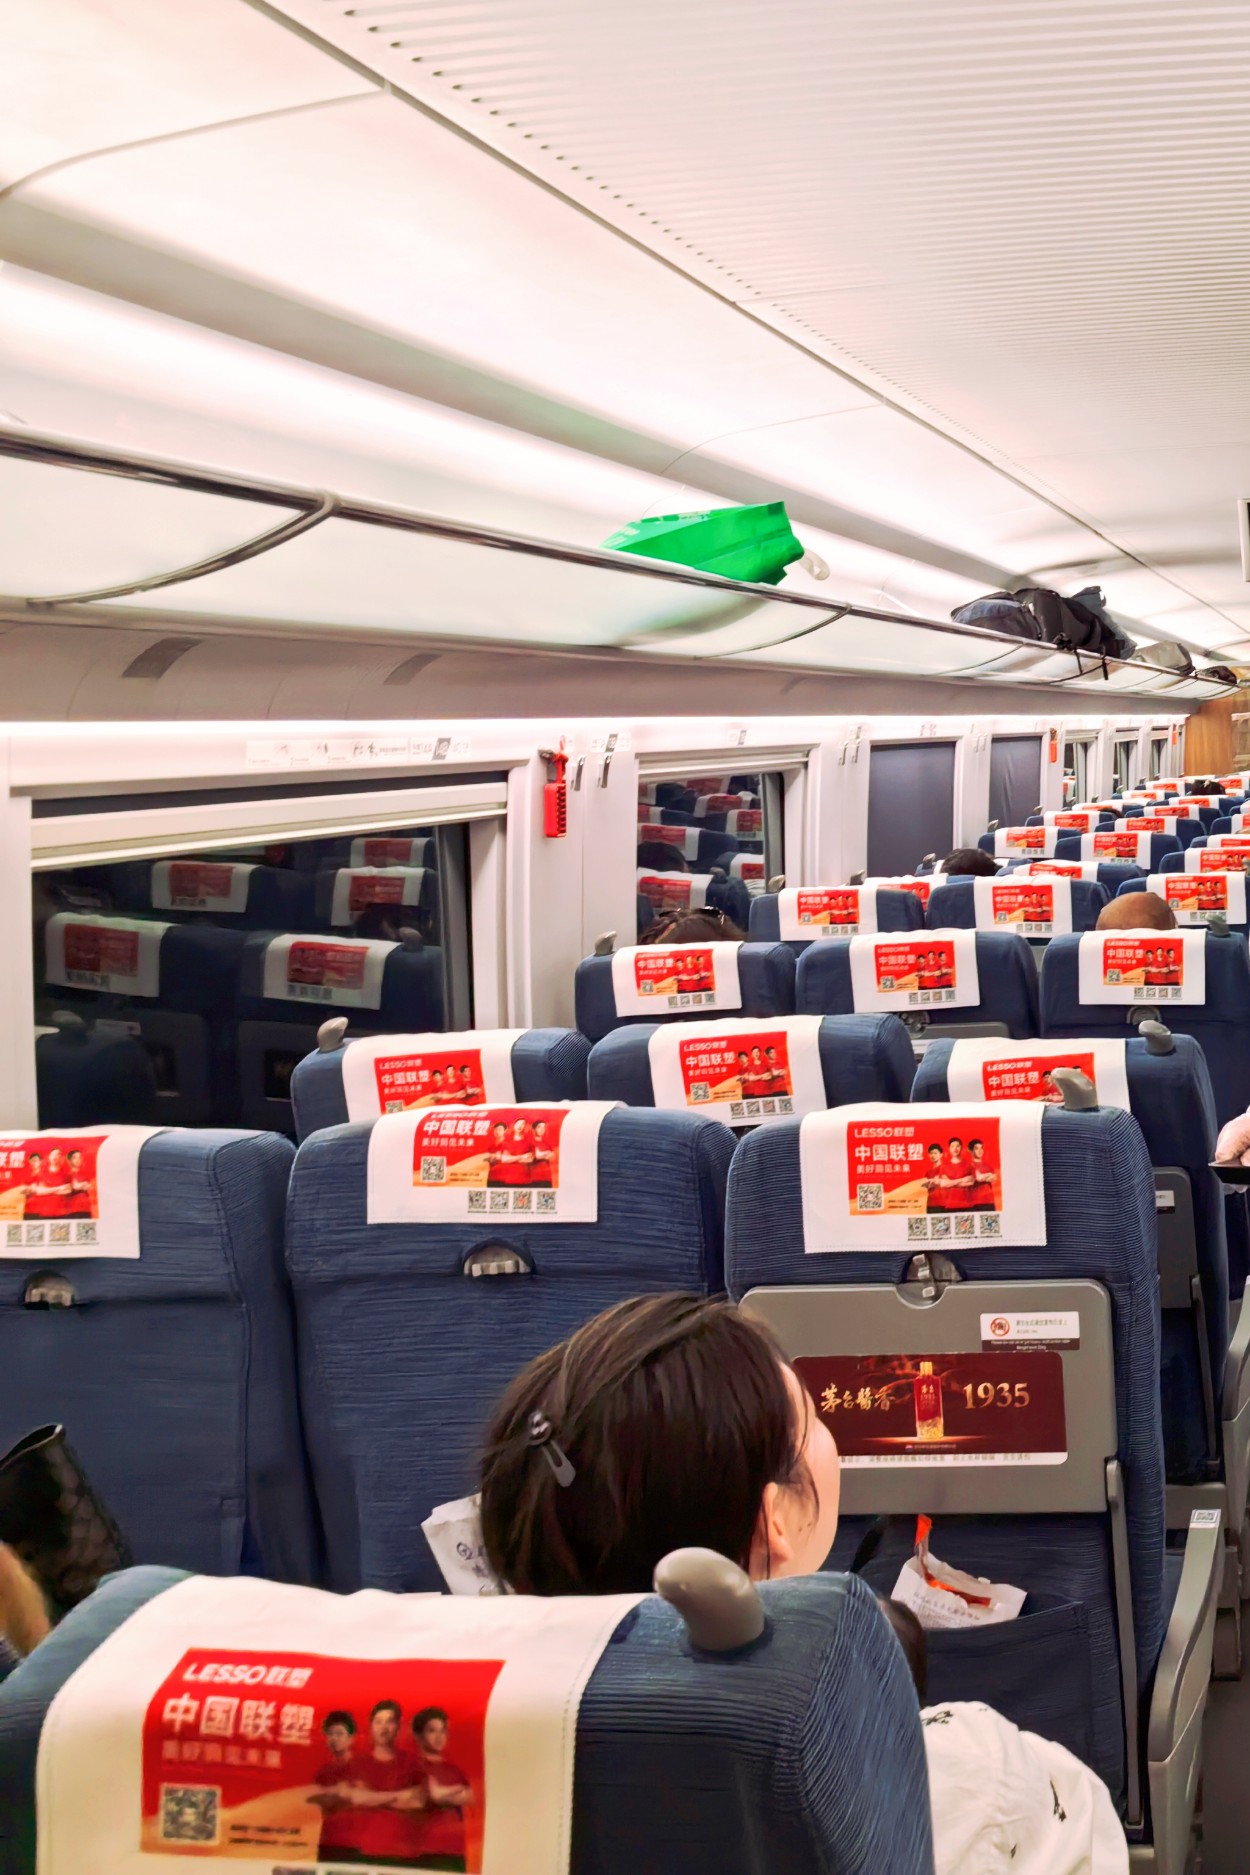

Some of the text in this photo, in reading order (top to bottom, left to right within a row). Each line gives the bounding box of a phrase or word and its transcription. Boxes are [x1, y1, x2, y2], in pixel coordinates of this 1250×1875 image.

[423, 1119, 491, 1136] 中国联塑
[854, 1143, 924, 1162] 中国联塑
[962, 1382, 1031, 1410] 1935
[162, 1692, 315, 1746] 中国联塑
